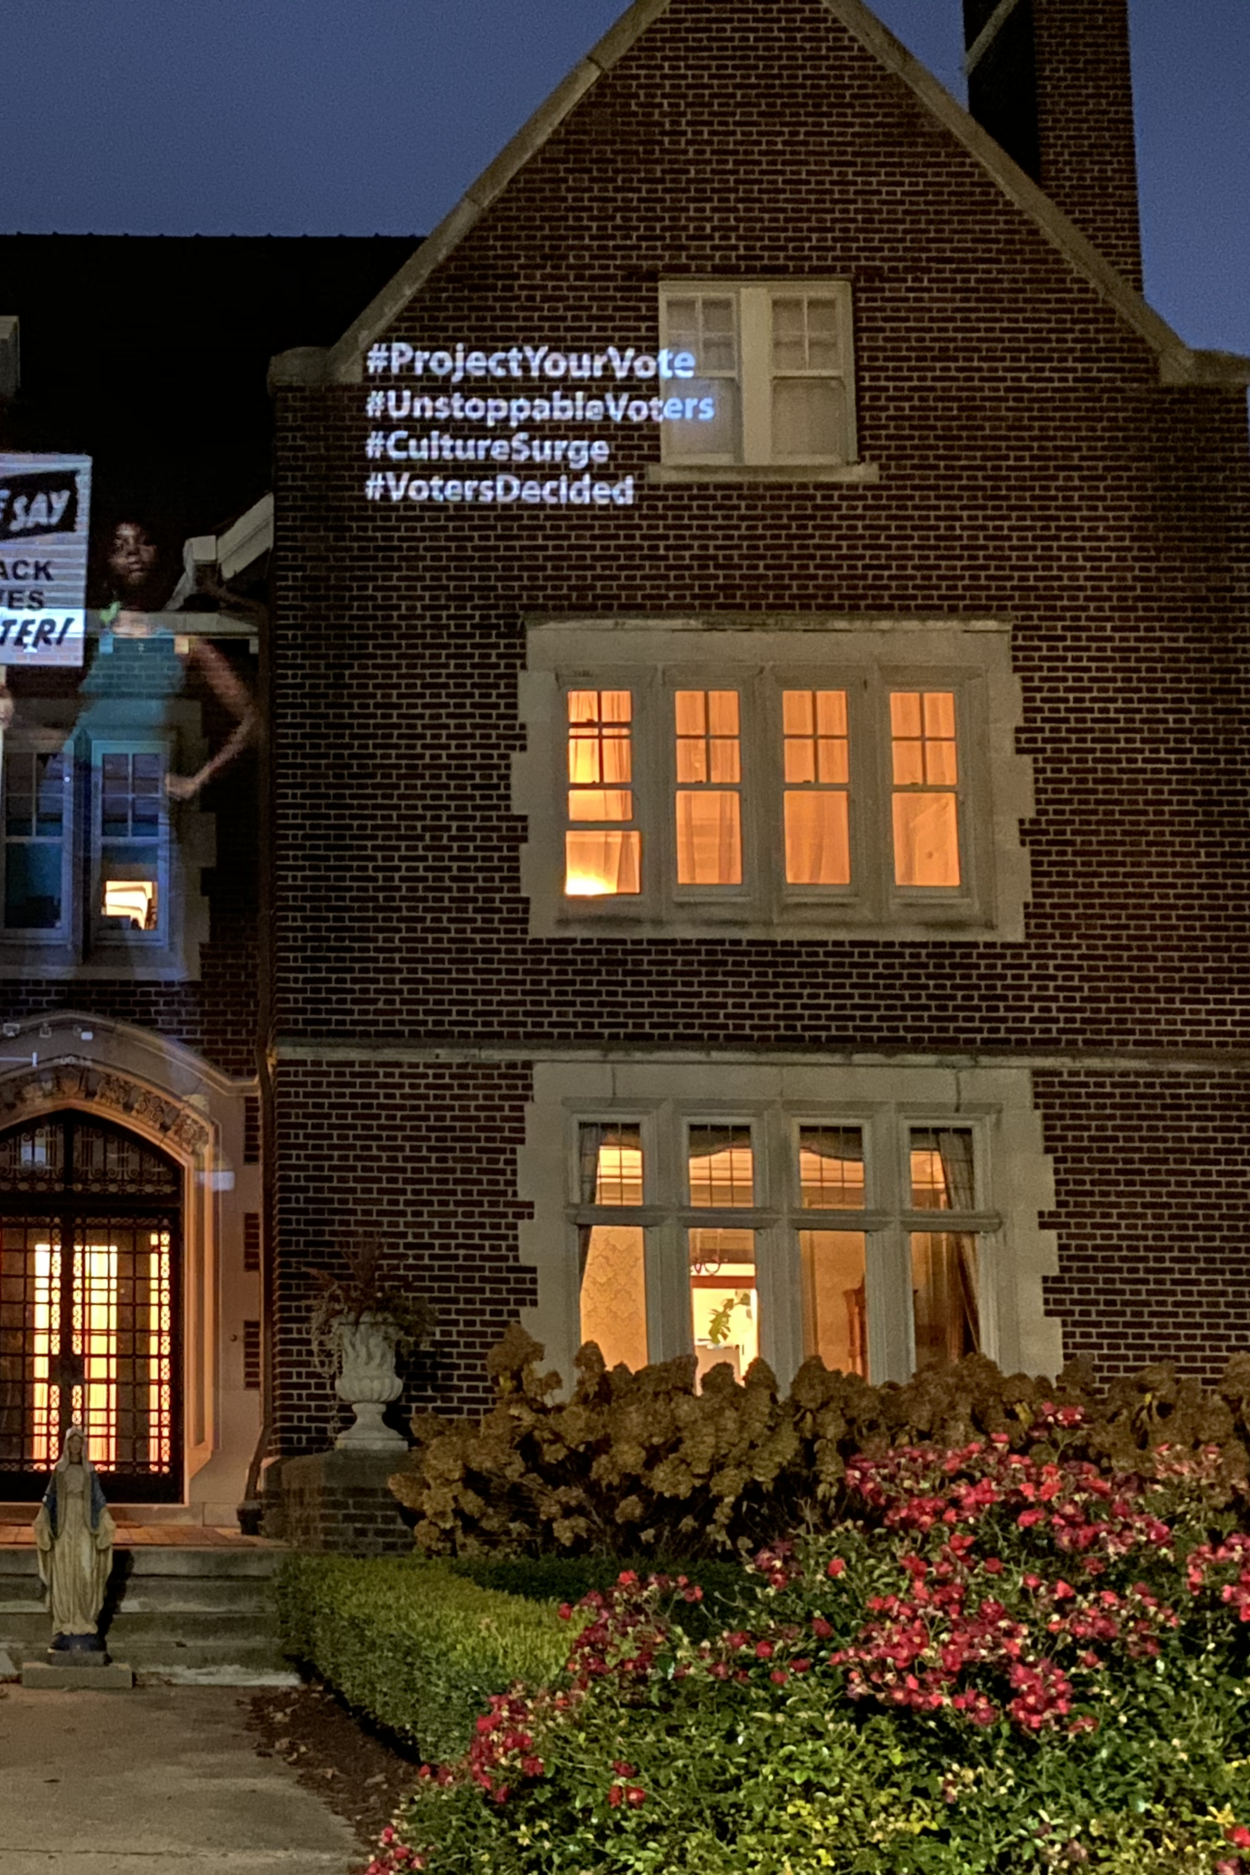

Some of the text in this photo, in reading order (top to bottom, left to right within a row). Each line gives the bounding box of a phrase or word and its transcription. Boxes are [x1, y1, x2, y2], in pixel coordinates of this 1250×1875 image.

[367, 342, 696, 382] #ProjectYourVote
[366, 390, 715, 427] #UnstoppableVoters
[365, 431, 611, 469] #CultureSurge
[365, 472, 635, 505] #VotersDecided
[9, 490, 71, 531] SAY
